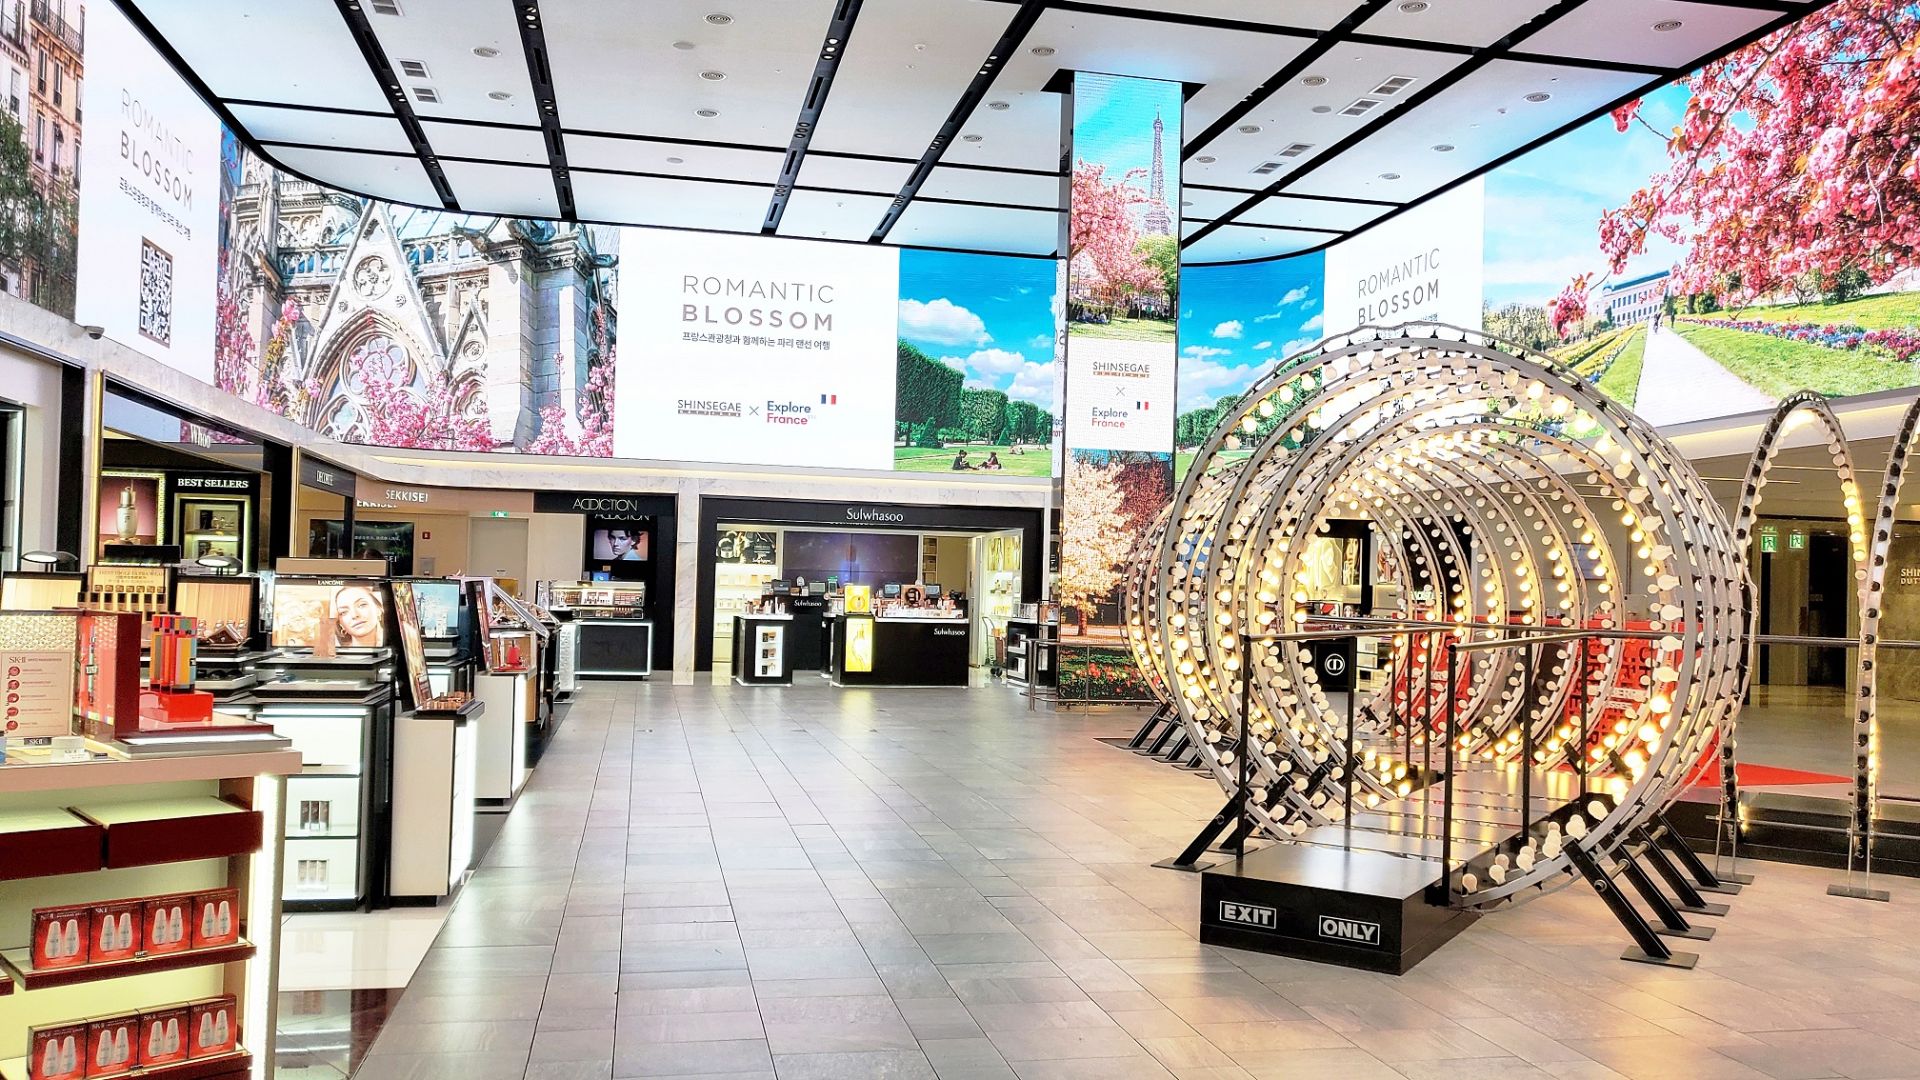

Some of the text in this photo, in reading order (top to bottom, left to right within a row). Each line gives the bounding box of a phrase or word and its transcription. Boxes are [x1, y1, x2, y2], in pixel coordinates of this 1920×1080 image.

[121, 88, 193, 175] ROMANTIC
[120, 130, 192, 212] BLOSSOM
[1358, 248, 1440, 299] ROMANTIC
[683, 275, 834, 304] ROMANTIC
[1358, 279, 1439, 327] BLOSSOM
[682, 304, 833, 332] BLOSSOM
[682, 331, 741, 345] 프랑스관광청과
[742, 335, 776, 348] 함께하는
[777, 337, 795, 349] 파리
[813, 340, 831, 351] 여행
[1092, 361, 1150, 373] SHINSEGAE
[677, 399, 742, 412] SHINSEGAE
[767, 400, 811, 415] Explore
[767, 413, 808, 425] France
[1092, 407, 1129, 419] Explore
[1091, 418, 1126, 428] France
[178, 478, 249, 489] BEST SELLERS
[385, 489, 428, 502] SEKKISEI
[572, 498, 638, 512] ADDICTION
[846, 508, 904, 522] Sulwhasoo
[934, 628, 966, 636] Sulwhasoo
[1224, 904, 1272, 925] EXIT
[1322, 919, 1376, 941] ONLY
